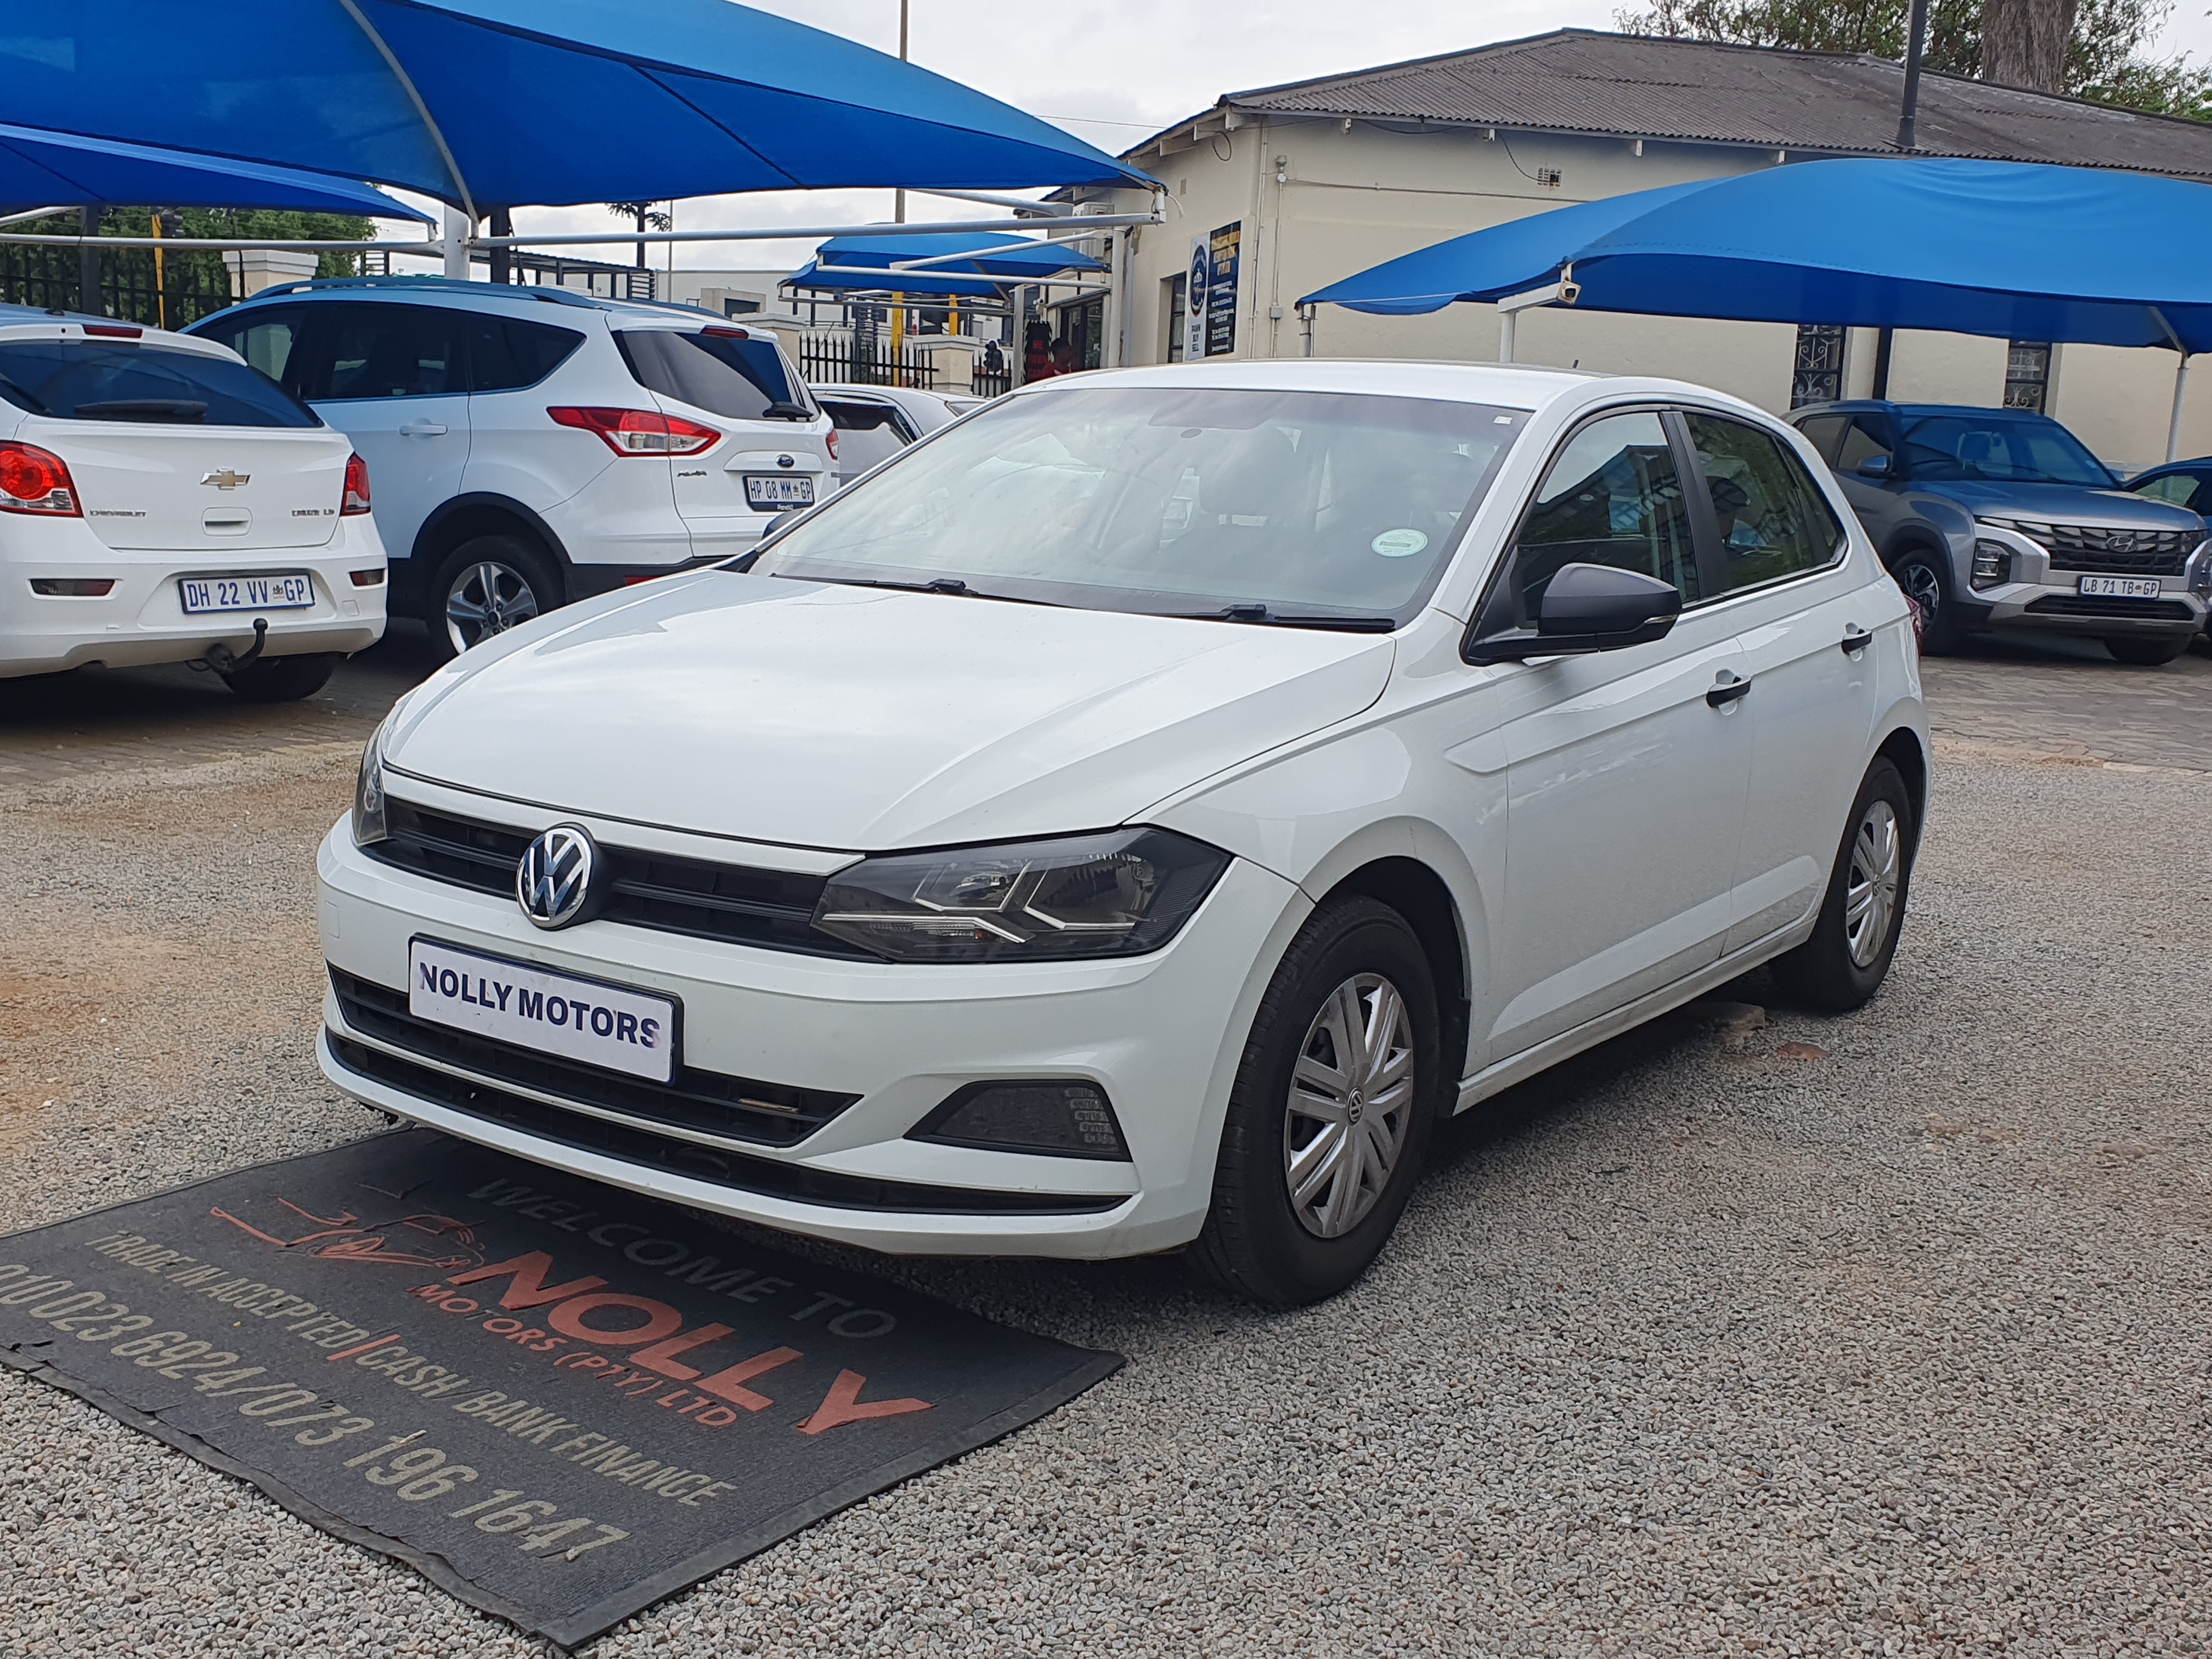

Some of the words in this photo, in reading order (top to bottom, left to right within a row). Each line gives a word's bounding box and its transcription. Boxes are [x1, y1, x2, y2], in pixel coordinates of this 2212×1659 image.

[749, 481, 761, 499] HP
[765, 481, 778, 499] 08
[780, 481, 793, 500] MM
[800, 482, 811, 500] GP
[187, 583, 211, 607] DH
[218, 582, 240, 606] 22
[247, 580, 268, 603] VV
[284, 579, 304, 602] GP
[2084, 579, 2098, 592] LB
[2103, 580, 2115, 594] 71
[2121, 581, 2134, 595] TB
[2143, 582, 2157, 595] GP
[420, 962, 513, 1011] NOLLY
[518, 988, 661, 1048] MOTORS
[467, 1178, 795, 1304] WELCOME
[790, 1290, 897, 1339] TO
[84, 1229, 198, 1273] TRADE
[166, 1264, 230, 1287] IN
[549, 1431, 738, 1507] FINANCE
[406, 1284, 568, 1351] MOTORS
[553, 1352, 664, 1396] (PTY)
[656, 1389, 737, 1426] LTD
[446, 1250, 935, 1435] NOLLY
[29, 1291, 154, 1342] 023
[343, 1432, 479, 1501] 196
[447, 1488, 631, 1551] 1647
